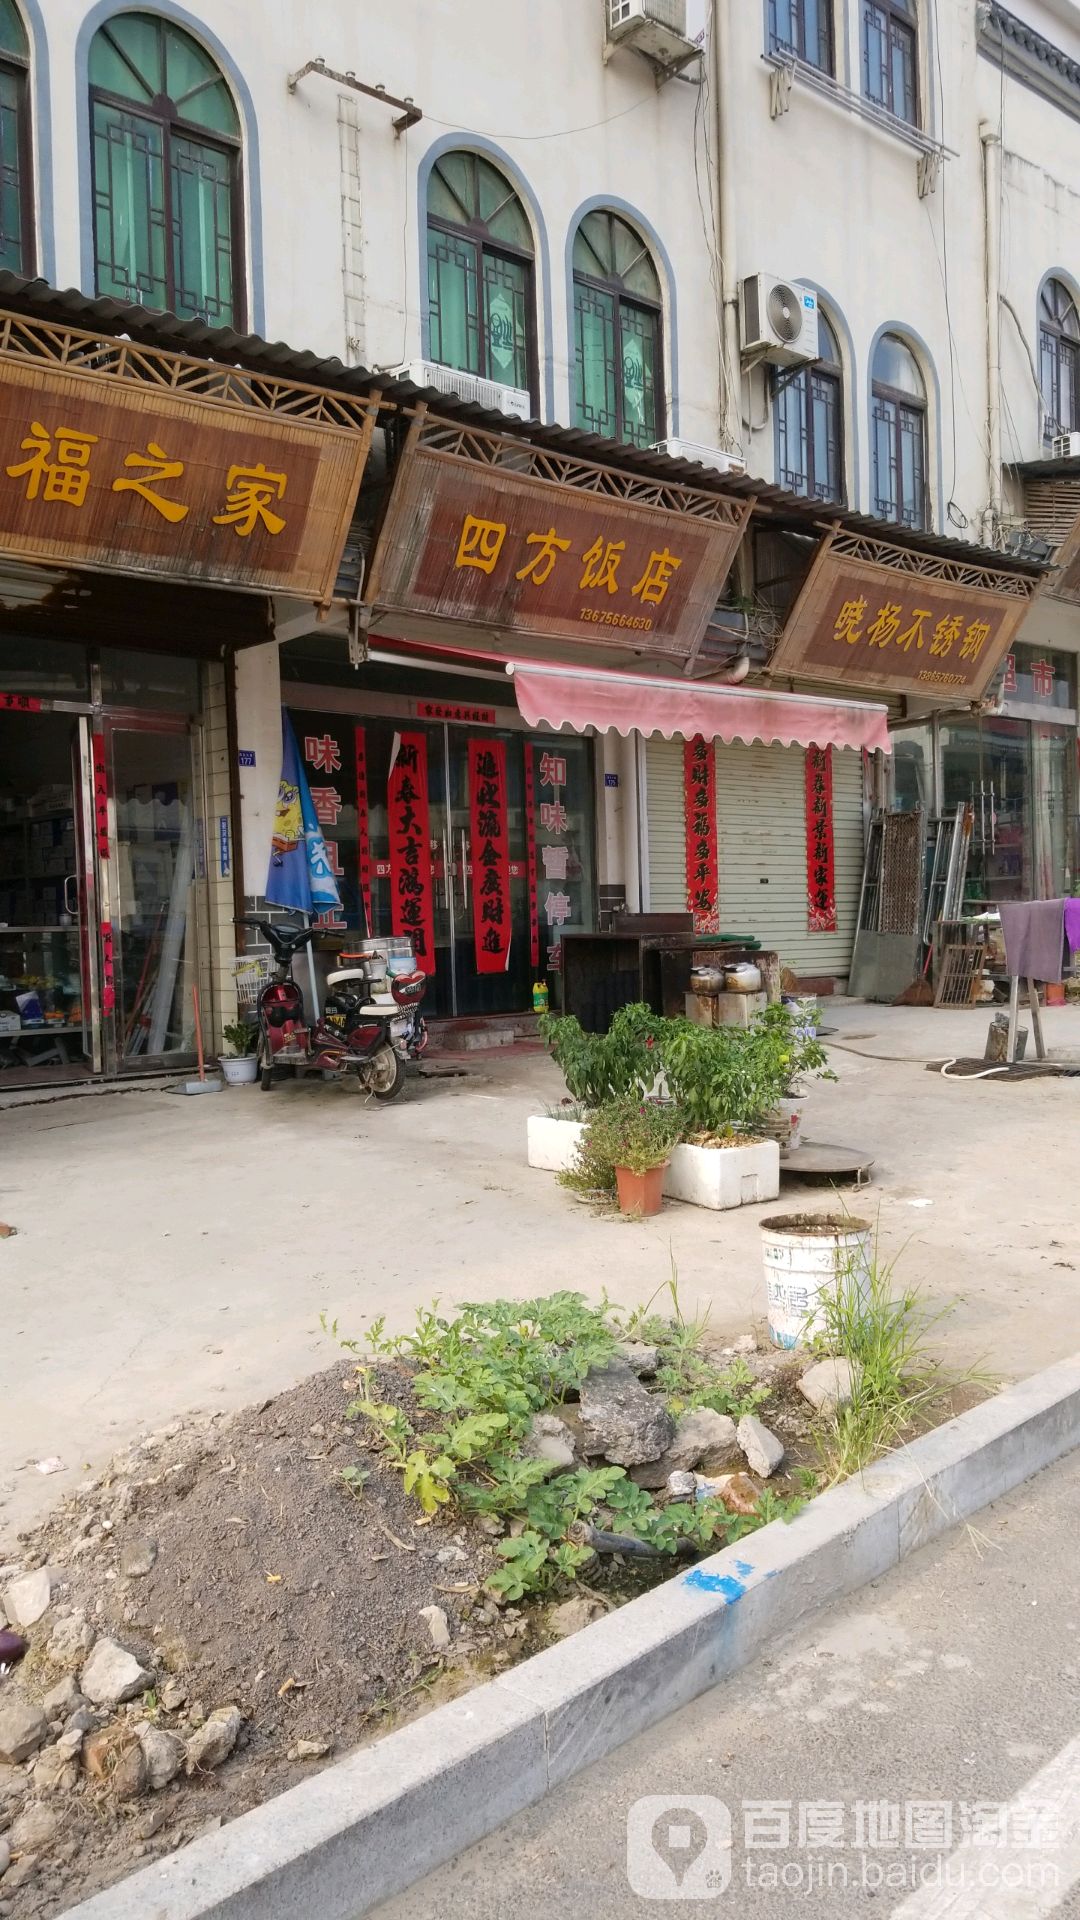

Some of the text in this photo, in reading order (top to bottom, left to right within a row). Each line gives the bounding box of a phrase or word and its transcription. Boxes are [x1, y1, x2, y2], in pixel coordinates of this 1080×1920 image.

[7, 421, 288, 537] 福之家
[455, 514, 682, 605] 四方饭店
[580, 608, 653, 630] 13675664630
[832, 594, 992, 664] 晓杨不锈钢
[241, 757, 252, 765] 177
[539, 752, 573, 972] 知味暂停车
